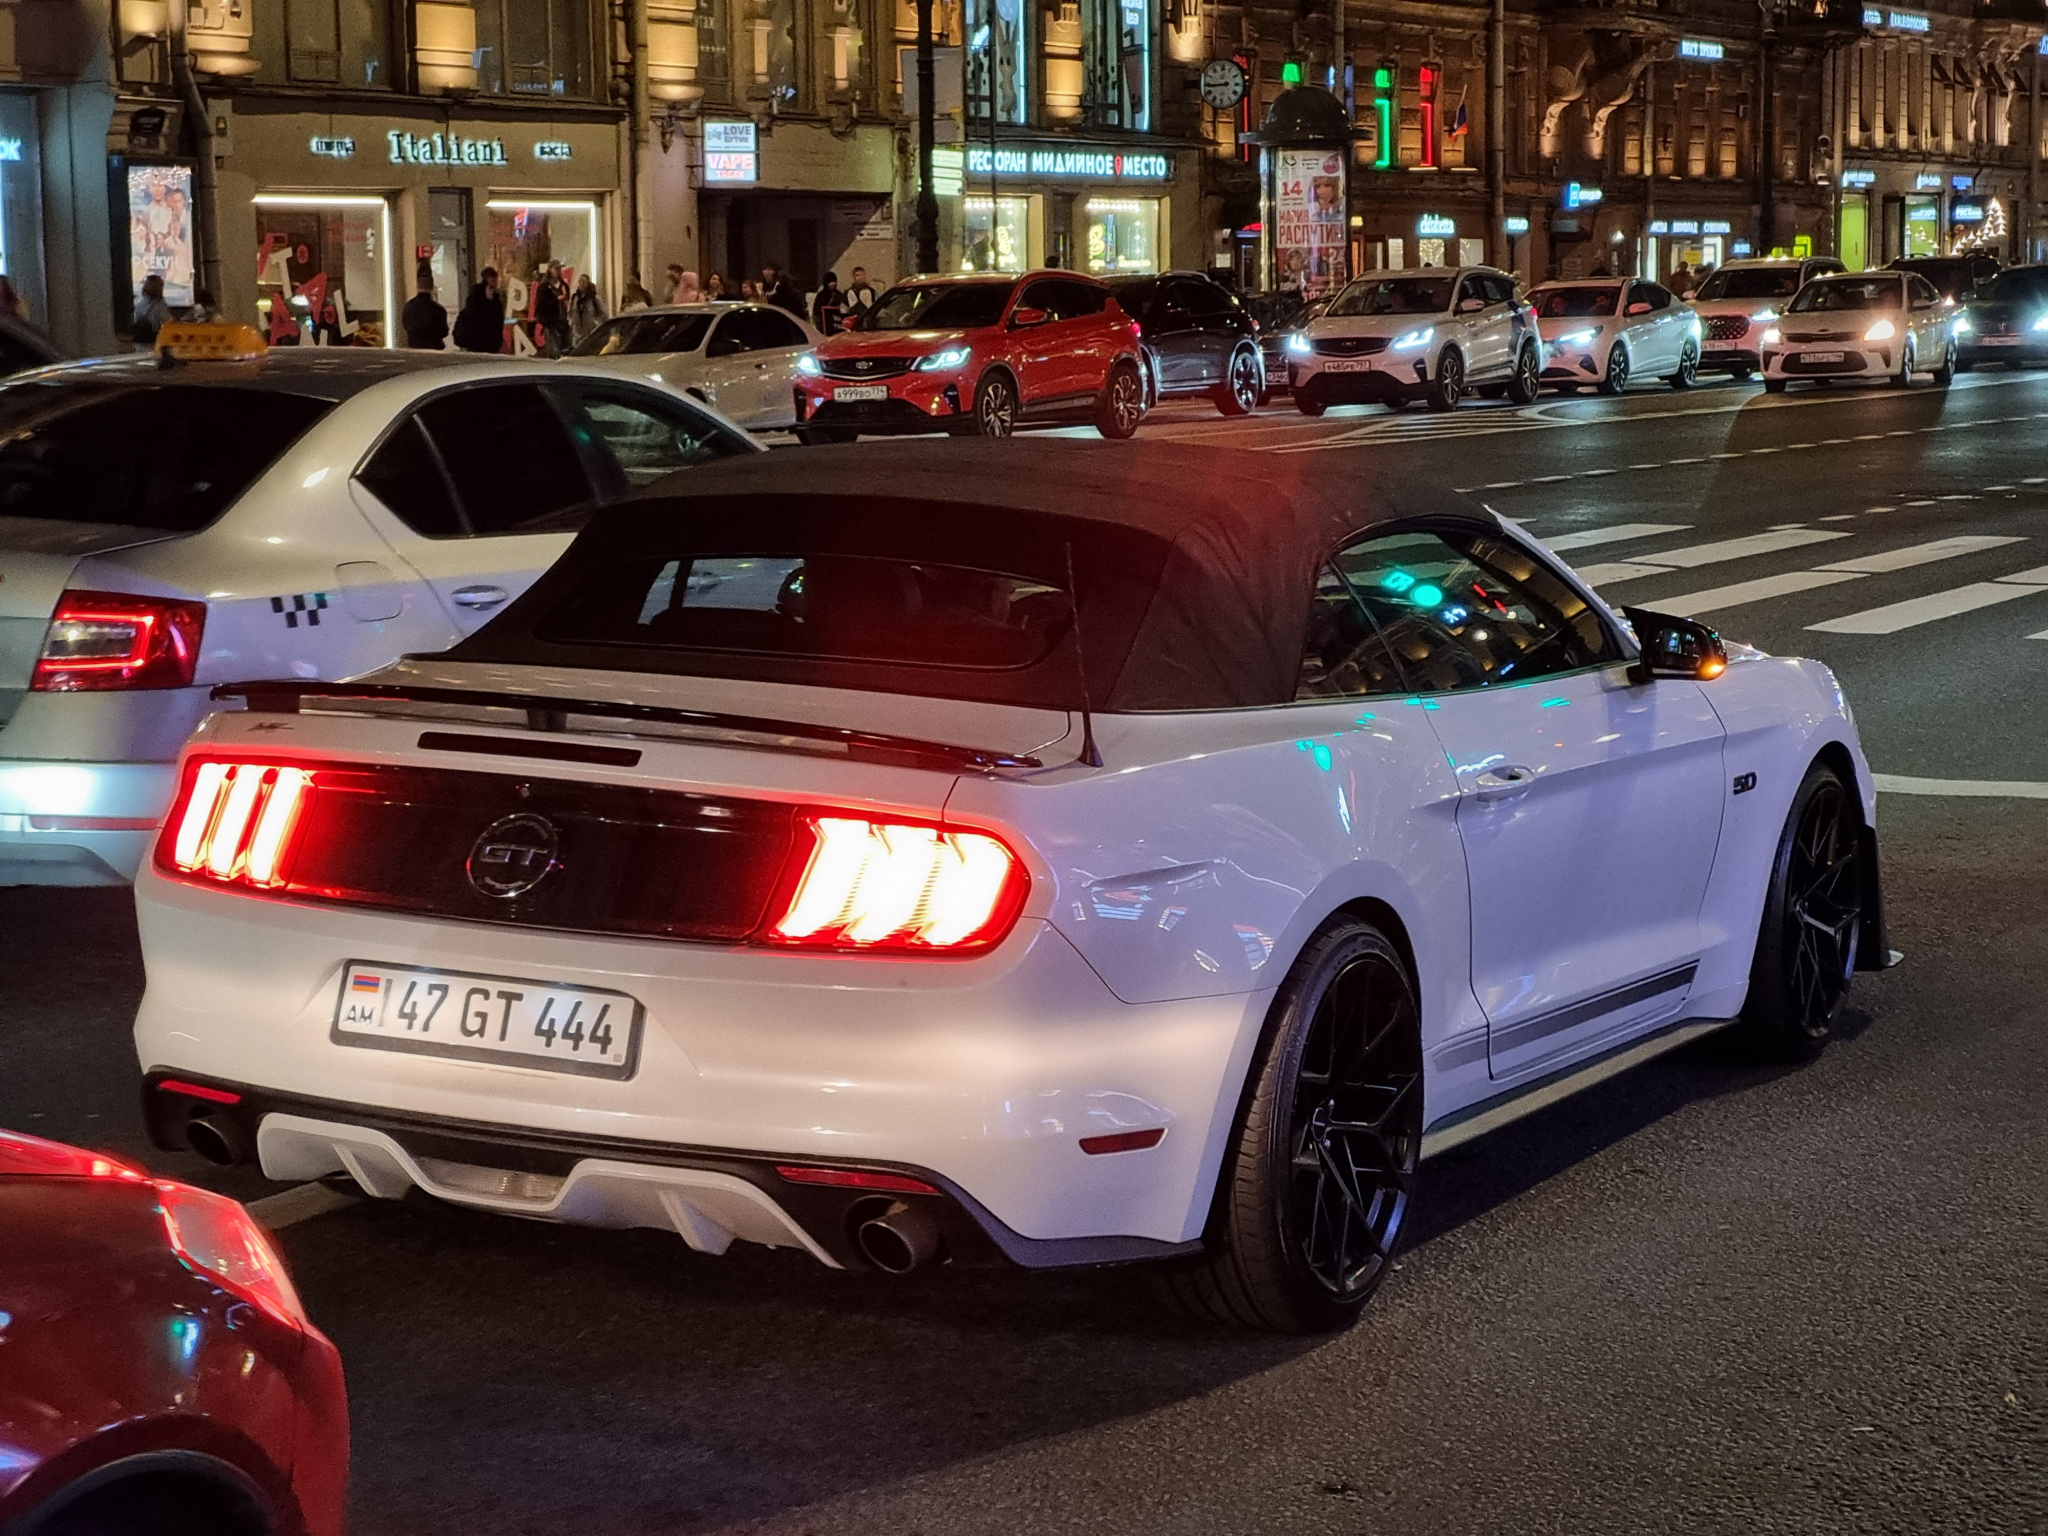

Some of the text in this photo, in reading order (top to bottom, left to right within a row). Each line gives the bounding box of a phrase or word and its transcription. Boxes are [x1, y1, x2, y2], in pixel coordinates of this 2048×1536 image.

[724, 126, 752, 135] LOVE
[389, 131, 508, 164] Italiani
[707, 154, 753, 169] VAPE
[969, 151, 1026, 173] РЕСОРАН
[1032, 152, 1114, 176] МИДИЙНОЕ
[1123, 155, 1167, 177] МЕСТО
[1281, 181, 1302, 196] 14
[343, 1004, 376, 1026] AM
[397, 980, 614, 1055] 47 GT 444
